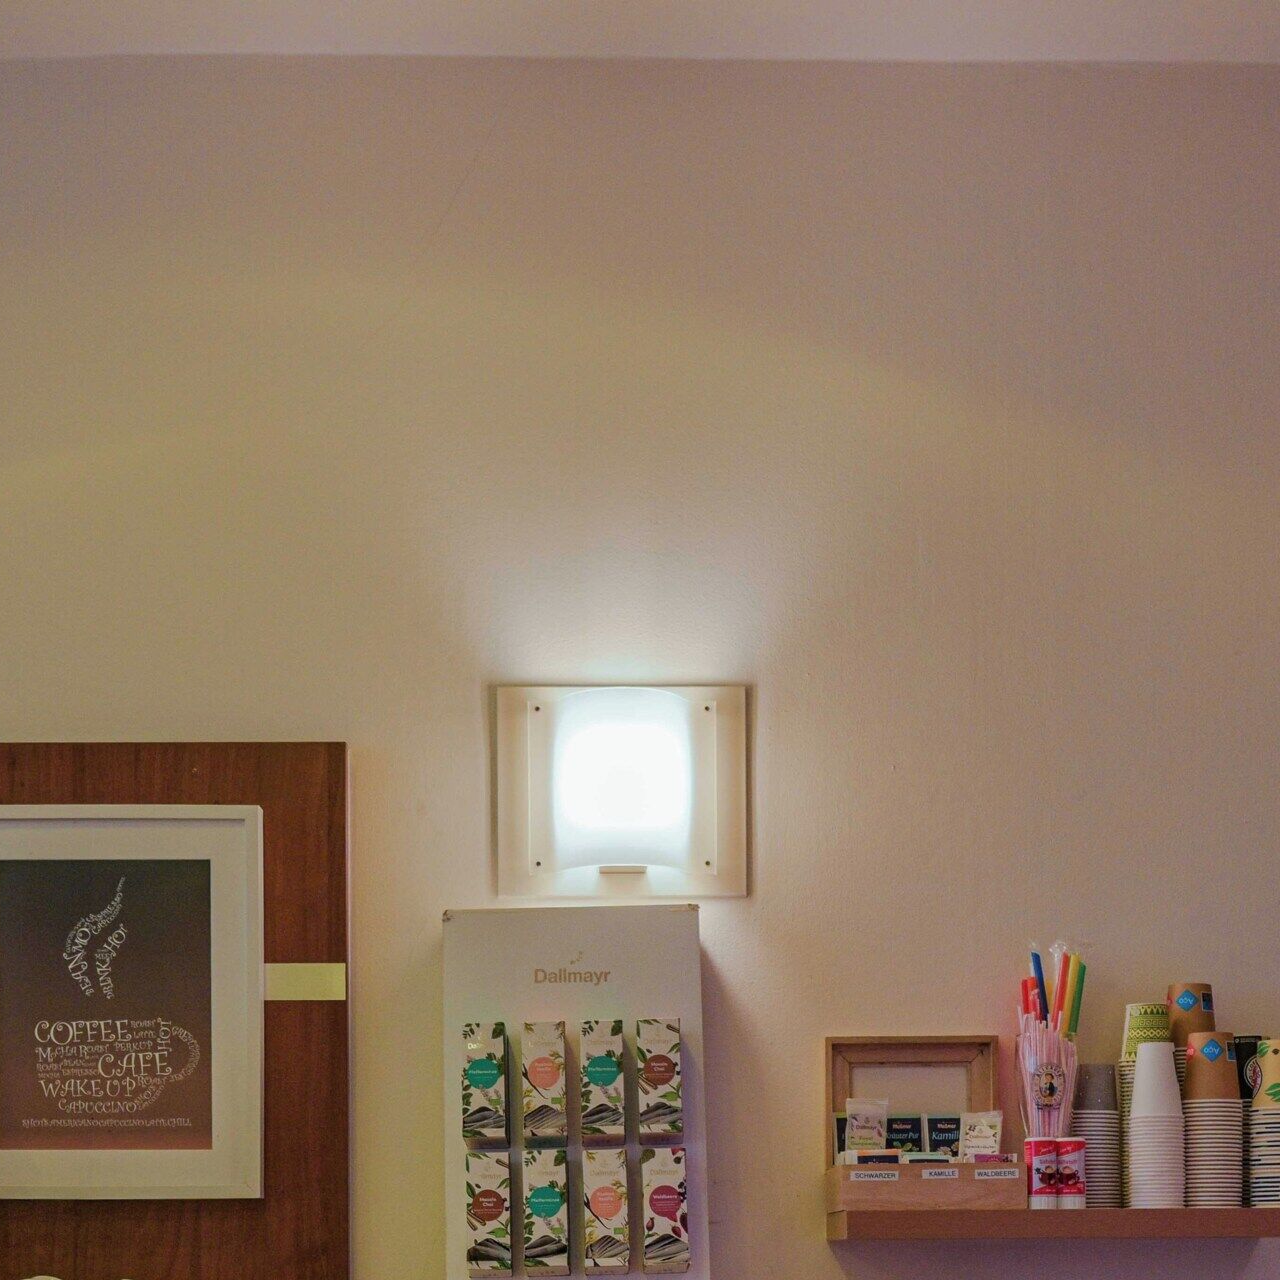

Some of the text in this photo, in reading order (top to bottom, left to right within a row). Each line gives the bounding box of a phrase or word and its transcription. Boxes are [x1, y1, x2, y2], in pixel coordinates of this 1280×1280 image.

[533, 968, 611, 986] Dallmayr
[35, 1020, 132, 1045] COFFEE
[98, 1052, 172, 1077] CAFE
[38, 1079, 104, 1097] WAKE
[106, 1077, 136, 1096] UP
[58, 1098, 137, 1113] CAPUCCINO
[931, 1131, 960, 1140] Kamill
